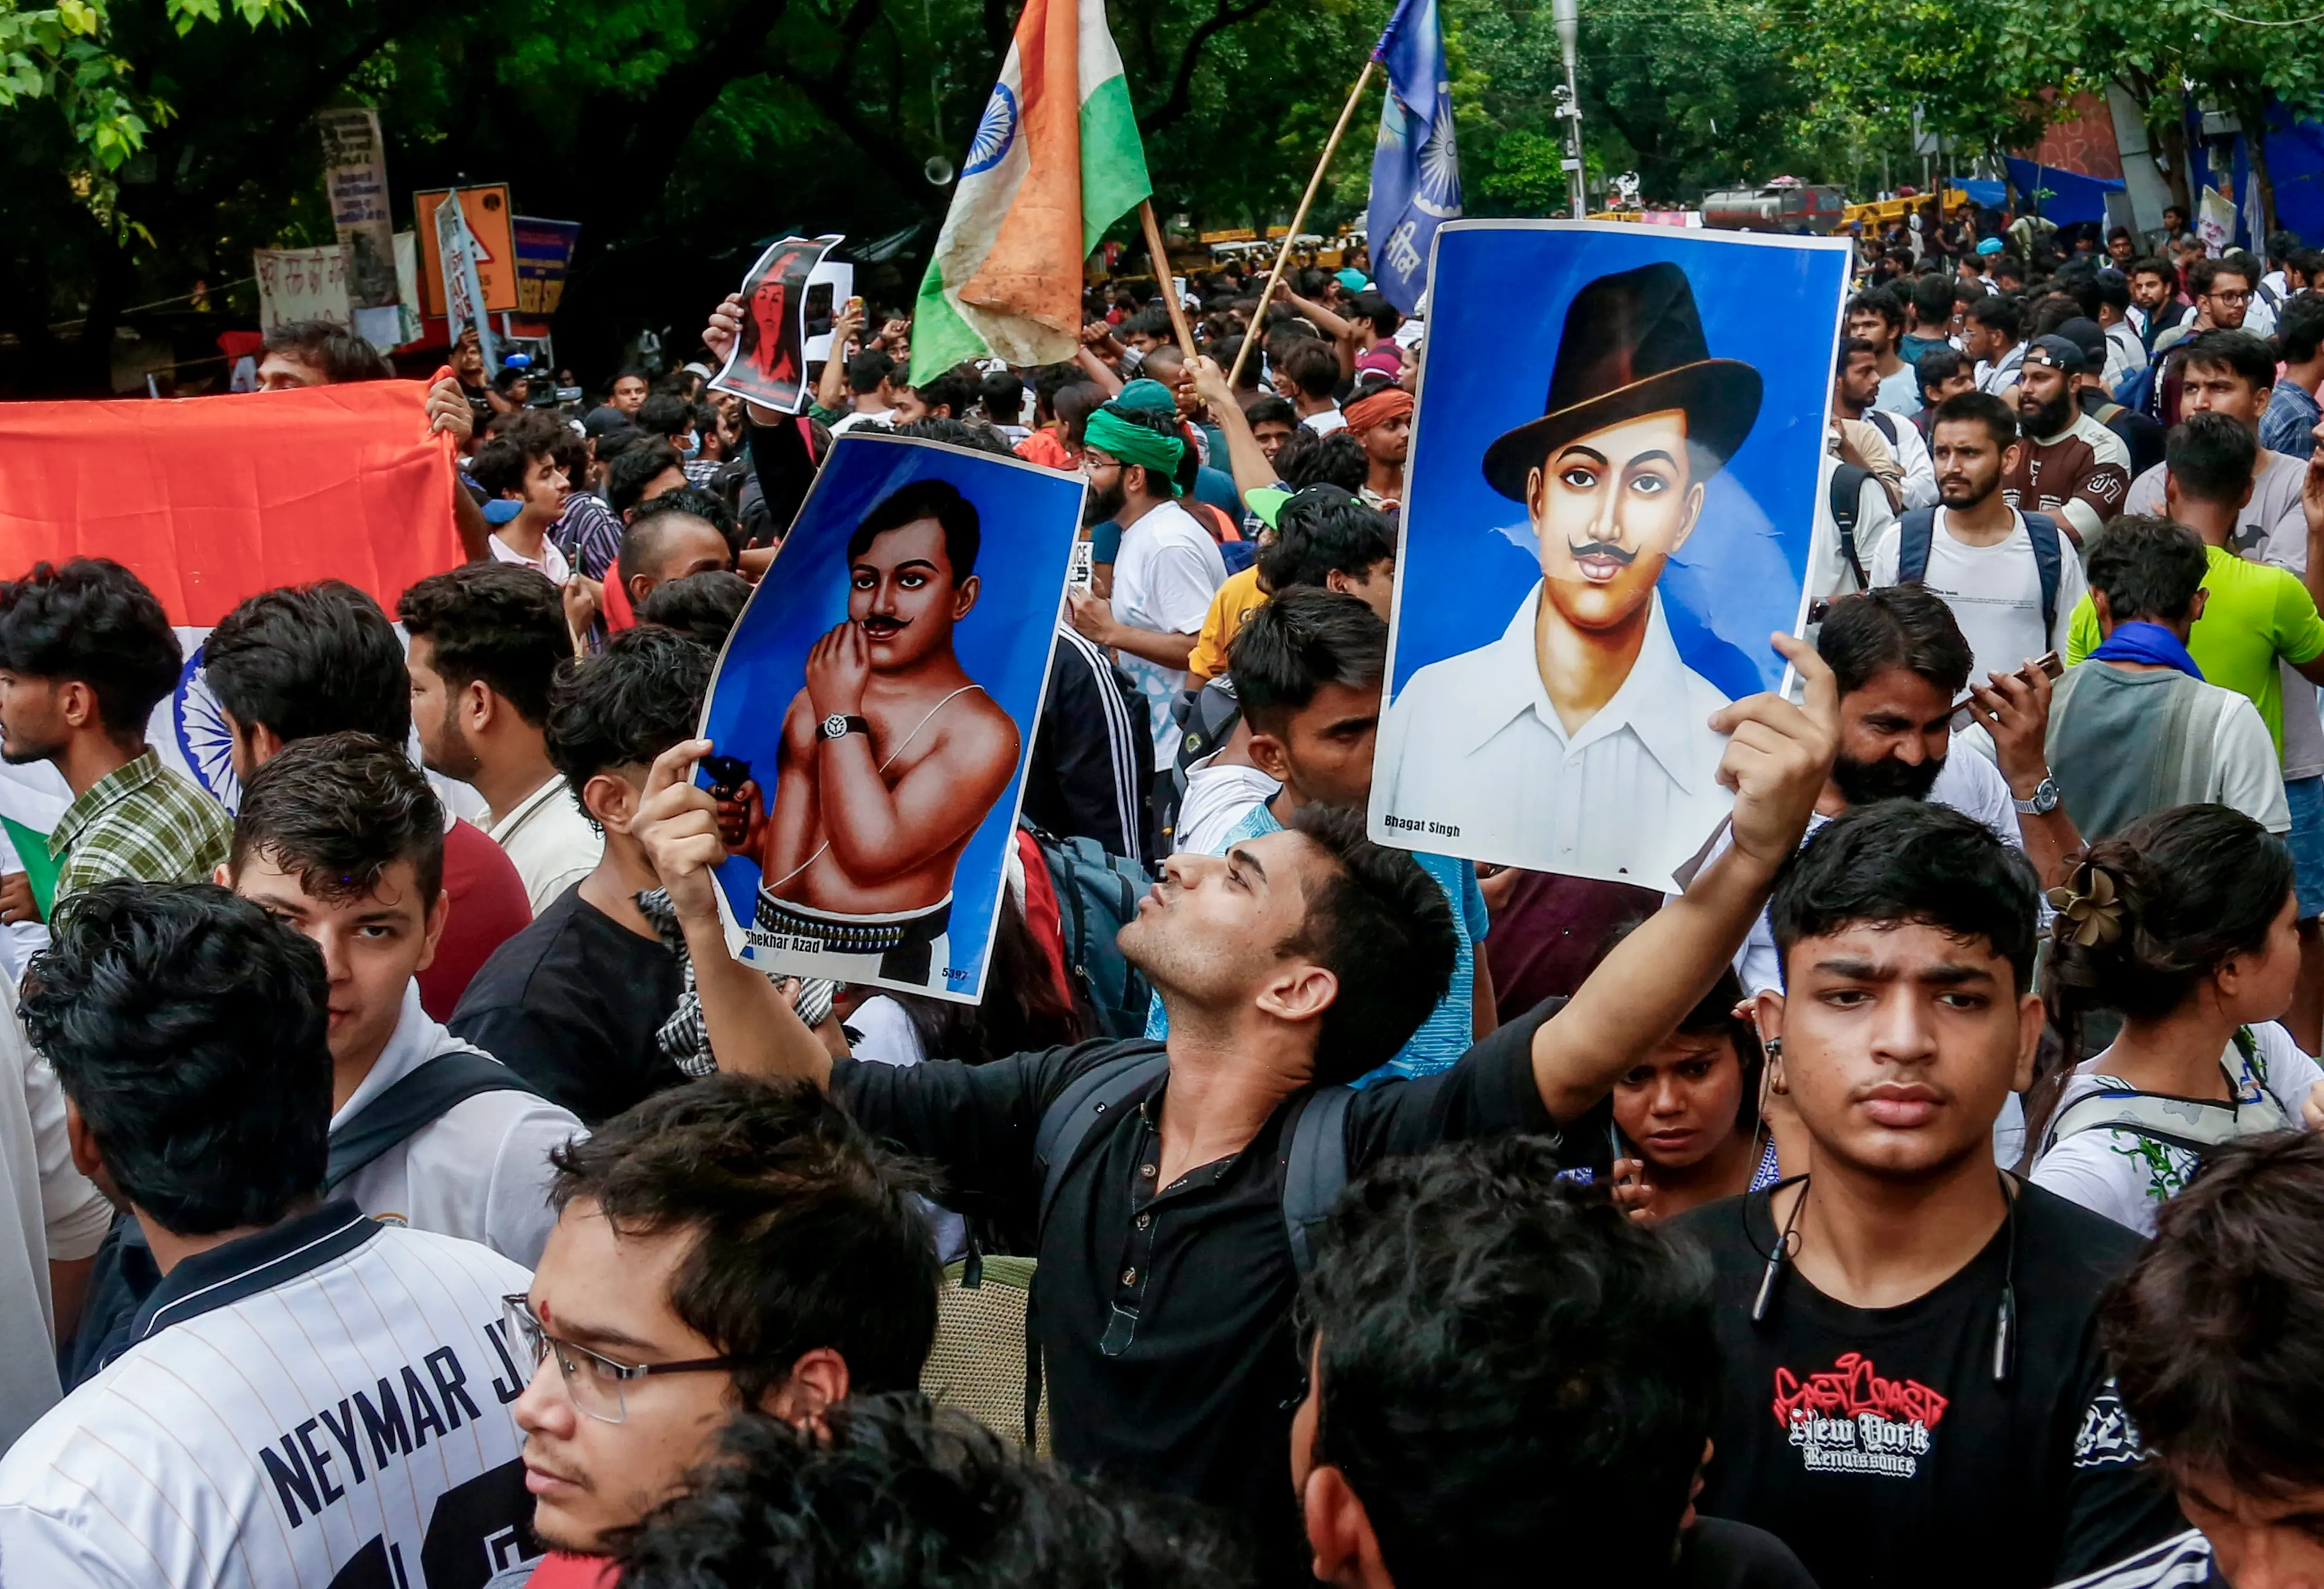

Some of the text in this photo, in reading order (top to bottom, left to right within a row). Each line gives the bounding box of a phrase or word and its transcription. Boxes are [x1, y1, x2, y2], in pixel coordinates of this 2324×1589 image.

[1385, 815, 1460, 837] Bhagat Singh
[791, 937, 820, 953] Azad
[942, 967, 968, 981] 5397
[259, 1346, 482, 1529] NEYMAR
[483, 1317, 525, 1404] J
[1789, 1408, 1930, 1455] New York
[1803, 1444, 1916, 1478] Renaissance
